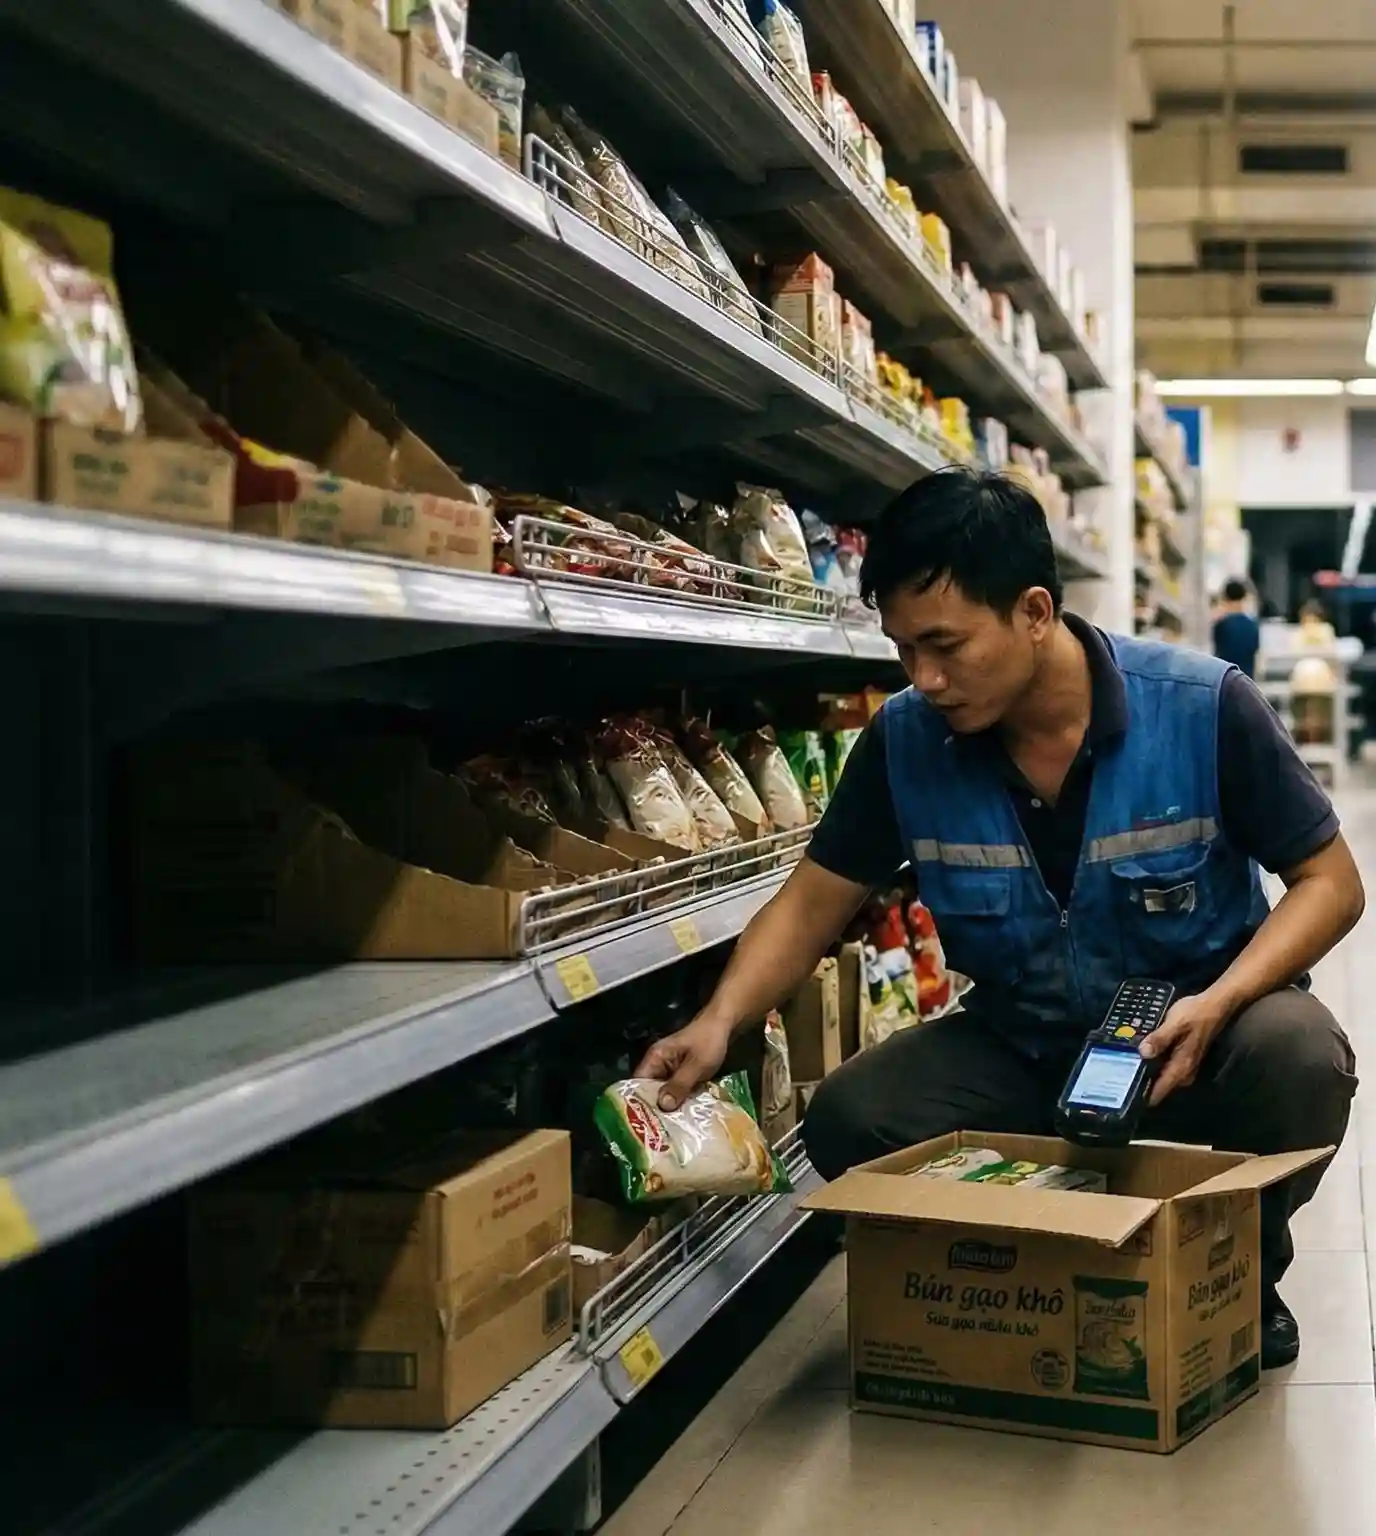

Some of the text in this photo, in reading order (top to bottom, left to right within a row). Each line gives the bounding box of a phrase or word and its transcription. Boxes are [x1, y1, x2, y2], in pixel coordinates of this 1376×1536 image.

[904, 1271, 954, 1303] Bún
[958, 1286, 1009, 1314] gạo
[1016, 1285, 1064, 1316] khô
